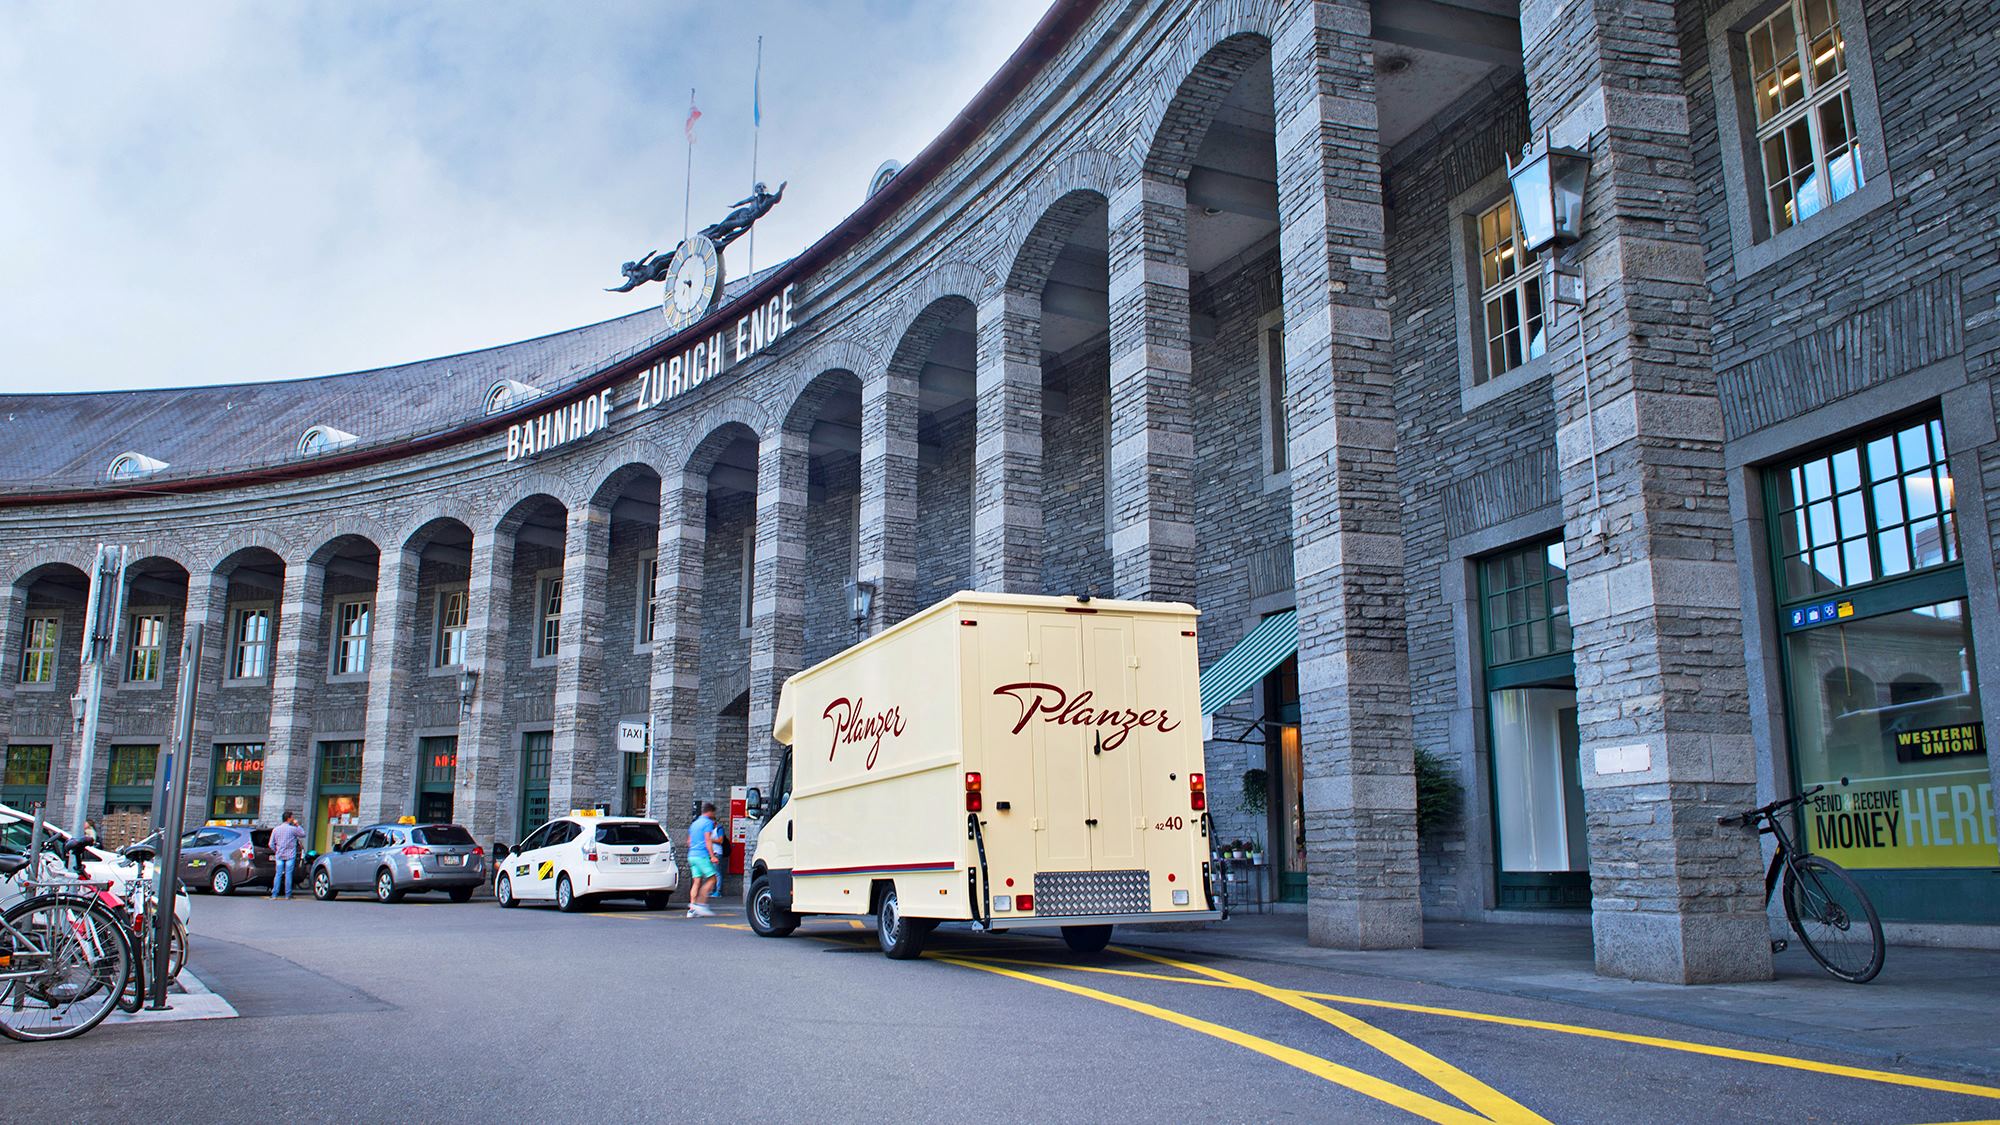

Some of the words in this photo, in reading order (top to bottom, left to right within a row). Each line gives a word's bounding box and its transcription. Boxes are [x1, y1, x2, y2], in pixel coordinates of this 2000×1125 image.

[507, 387, 614, 462] BAHNHOF
[736, 282, 796, 363] ENGE
[622, 727, 642, 738] TAXI
[822, 697, 907, 771] Planzer
[993, 682, 1181, 751] Planzer
[1898, 726, 1973, 745] WESTERN
[1922, 738, 1974, 755] UNION
[1815, 794, 1842, 813] SEND
[1853, 790, 1899, 810] RECEIVE
[1901, 783, 1997, 847] HERE
[1816, 810, 1899, 849] MONEY
